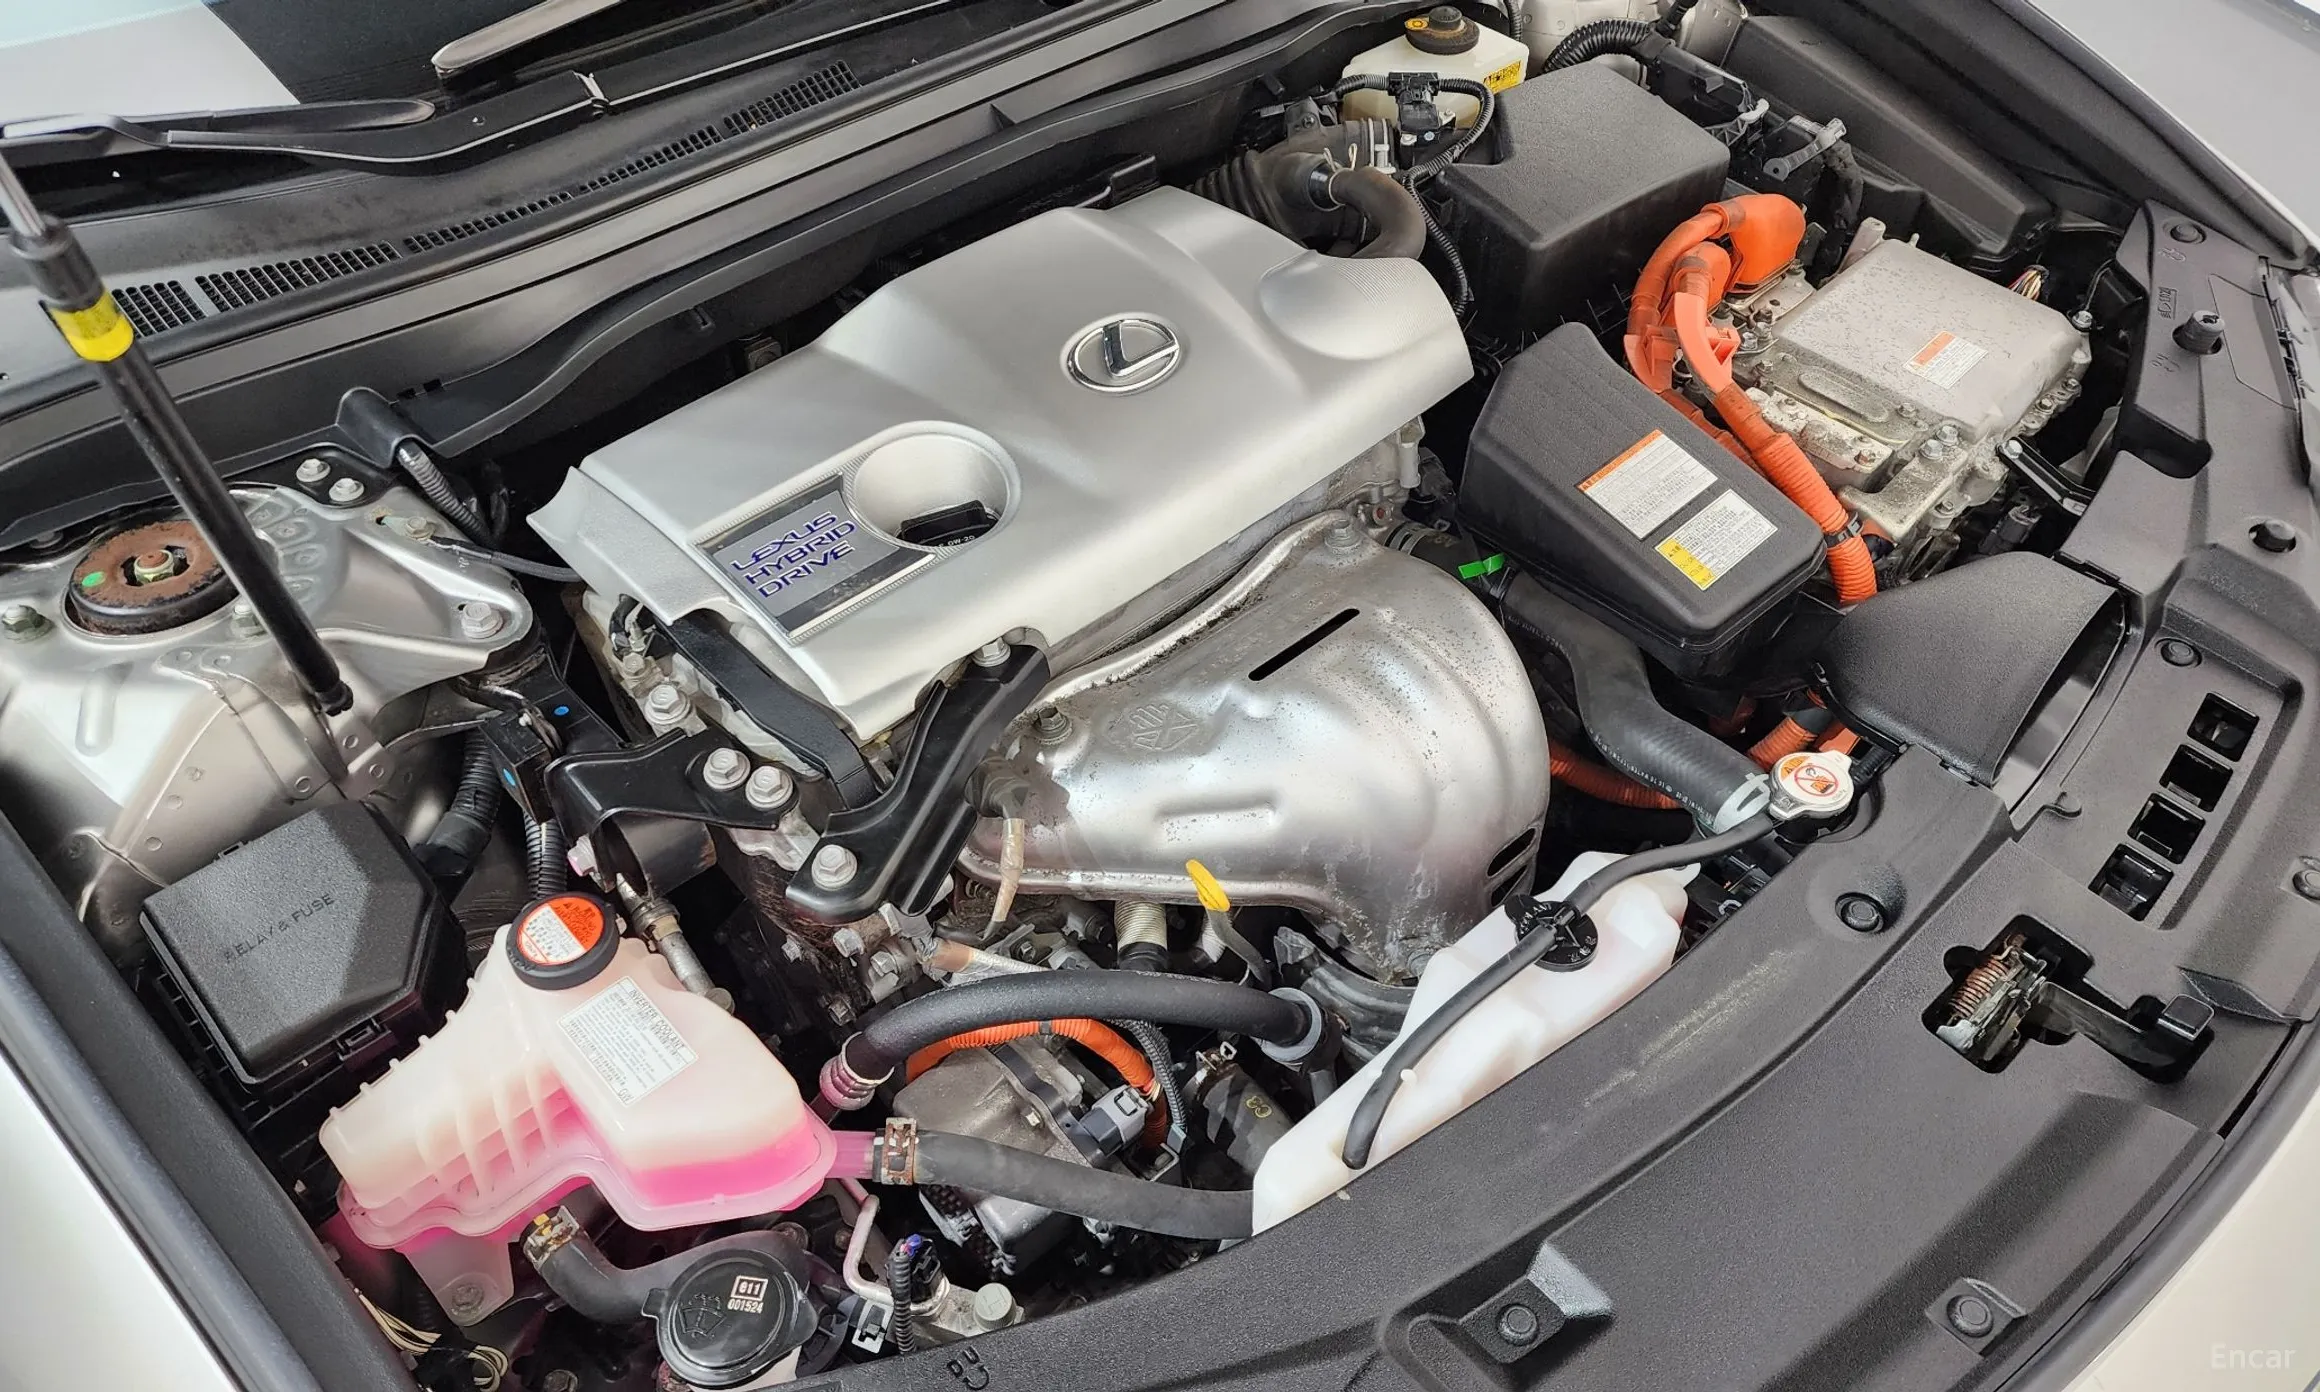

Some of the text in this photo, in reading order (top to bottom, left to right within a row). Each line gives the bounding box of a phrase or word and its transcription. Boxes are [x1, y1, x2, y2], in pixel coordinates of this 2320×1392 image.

[731, 511, 839, 571] LEXUS
[745, 520, 857, 585] HYBRID
[757, 540, 855, 598] DRIVE
[291, 893, 335, 923] FUSE
[628, 988, 686, 1051] INVERTER COOLANT
[727, 1298, 764, 1314] 001524
